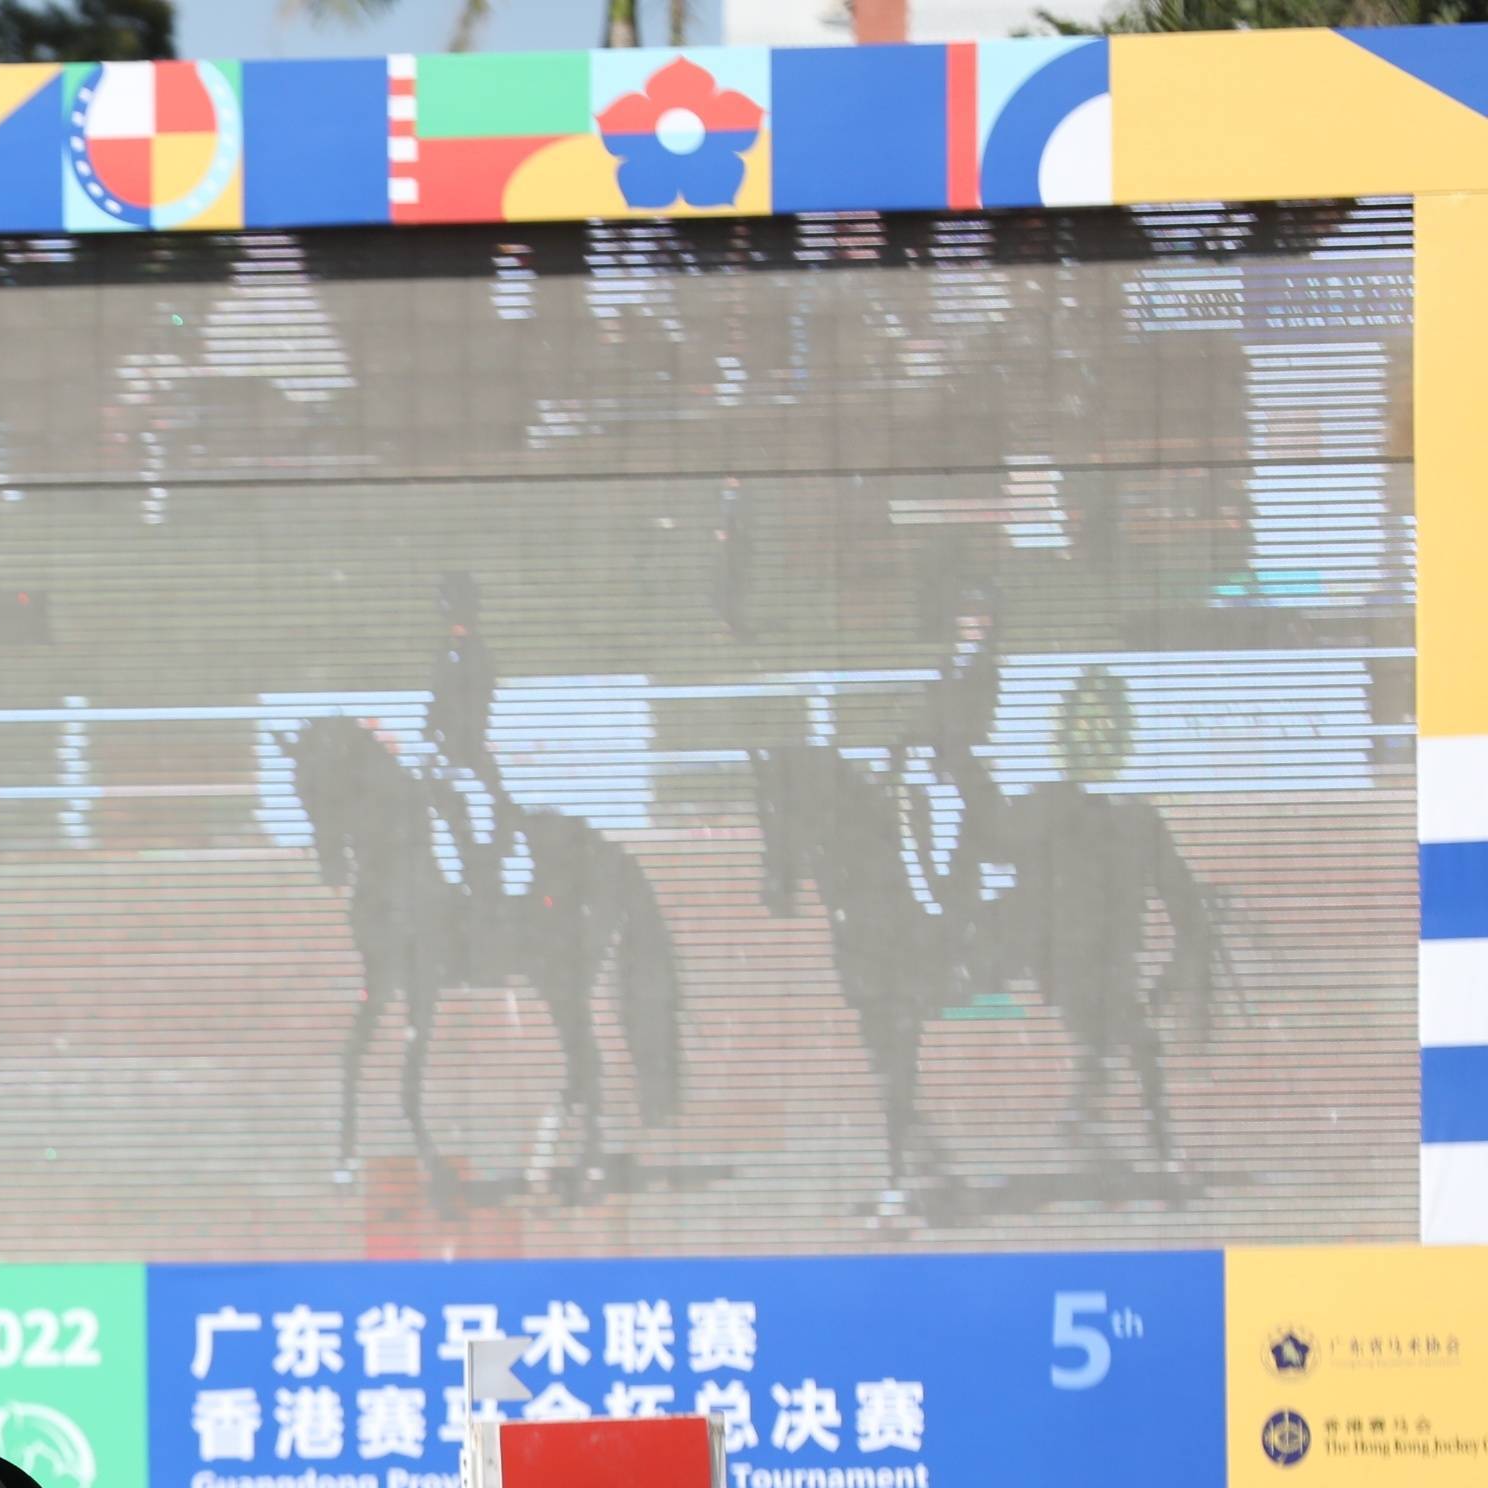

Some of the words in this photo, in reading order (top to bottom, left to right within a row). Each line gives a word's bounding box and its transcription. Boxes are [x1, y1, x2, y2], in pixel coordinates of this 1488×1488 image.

[190, 1298, 757, 1379] 广东省马术联赛
[1050, 1291, 1144, 1390] 5th
